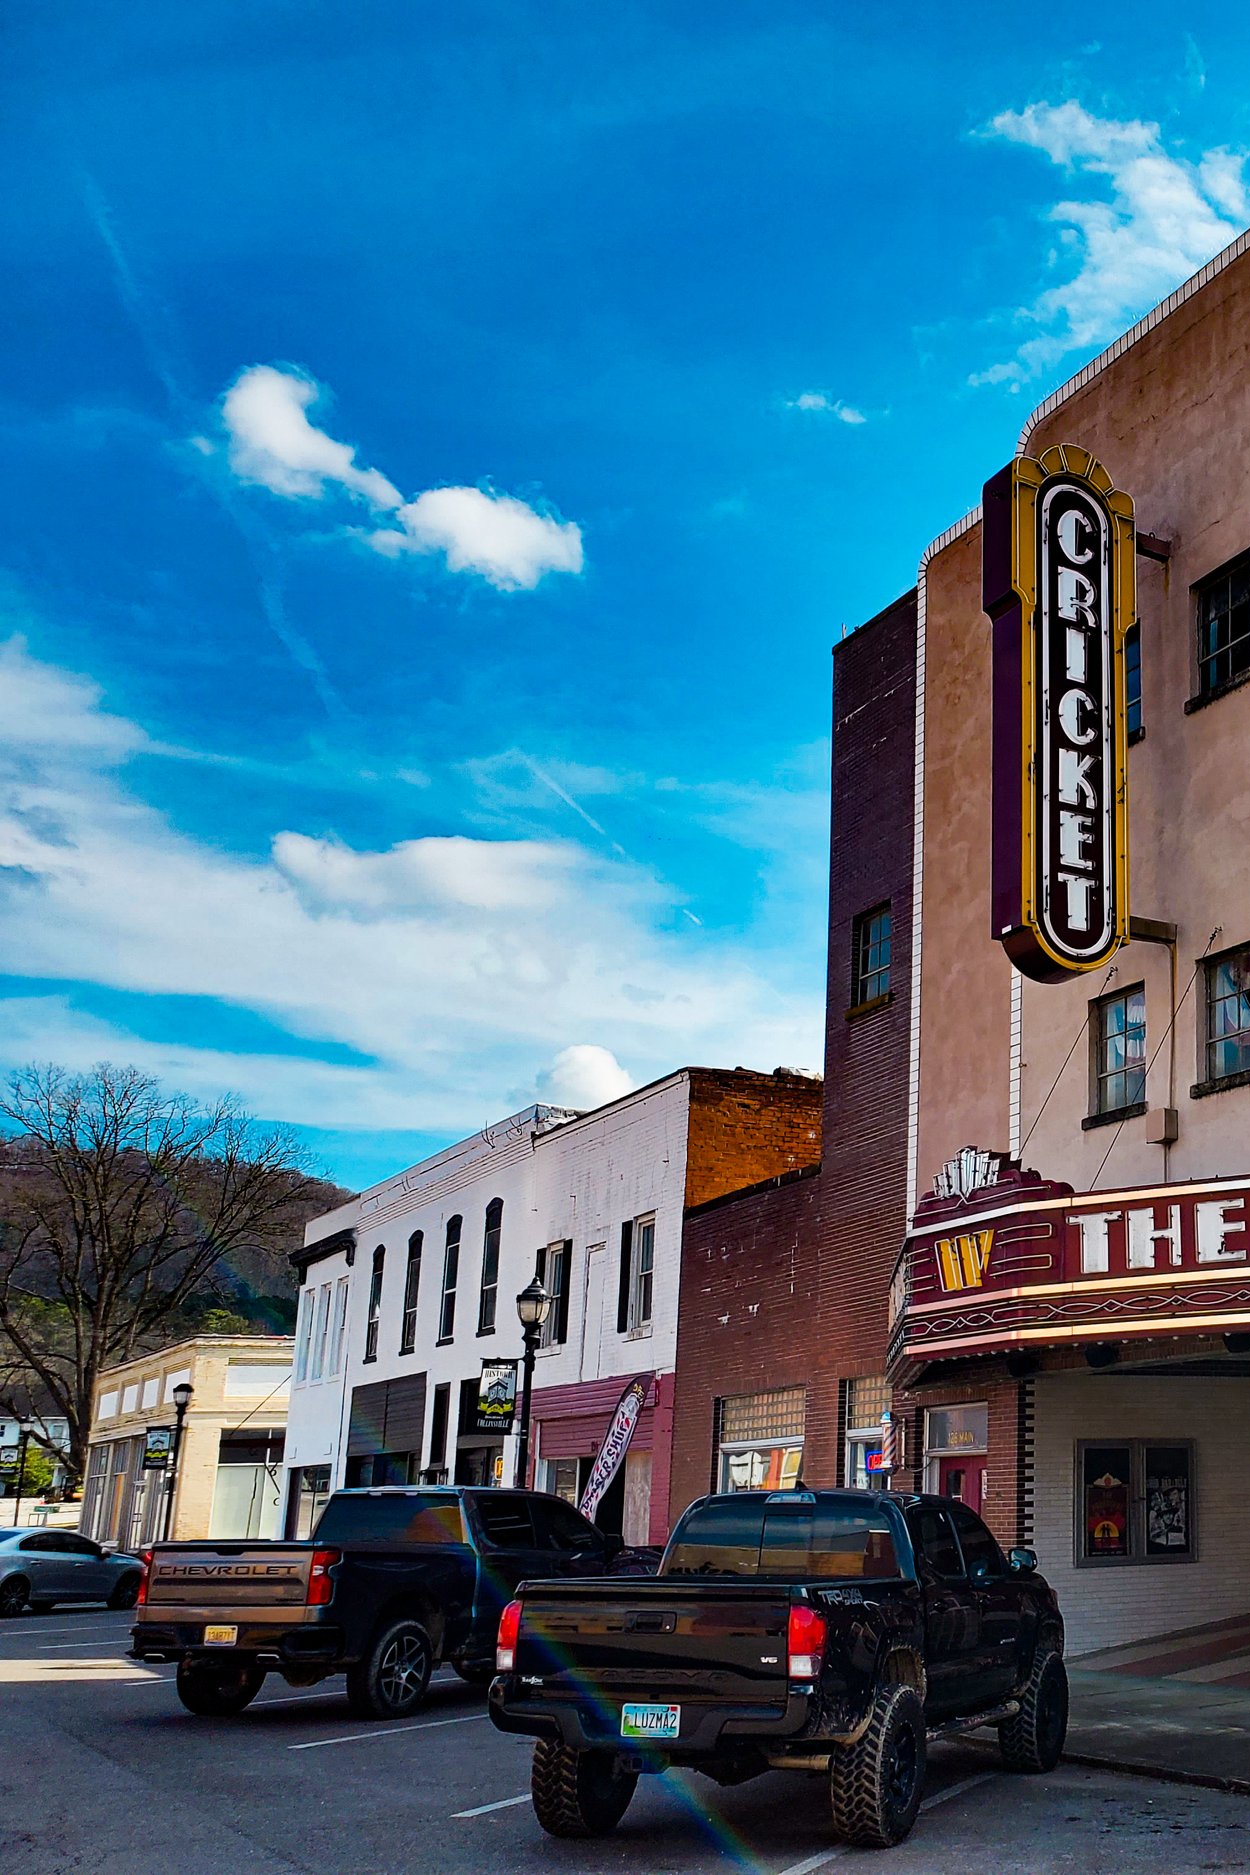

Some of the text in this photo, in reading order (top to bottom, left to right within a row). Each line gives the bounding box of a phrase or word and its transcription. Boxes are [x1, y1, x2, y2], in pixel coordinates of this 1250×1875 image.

[1056, 508, 1100, 932] CRICKET
[959, 1431, 974, 1443] MAIN
[158, 1565, 298, 1576] CHEVROLET
[760, 1656, 778, 1664] V6
[634, 1712, 677, 1730] LUZMA2
